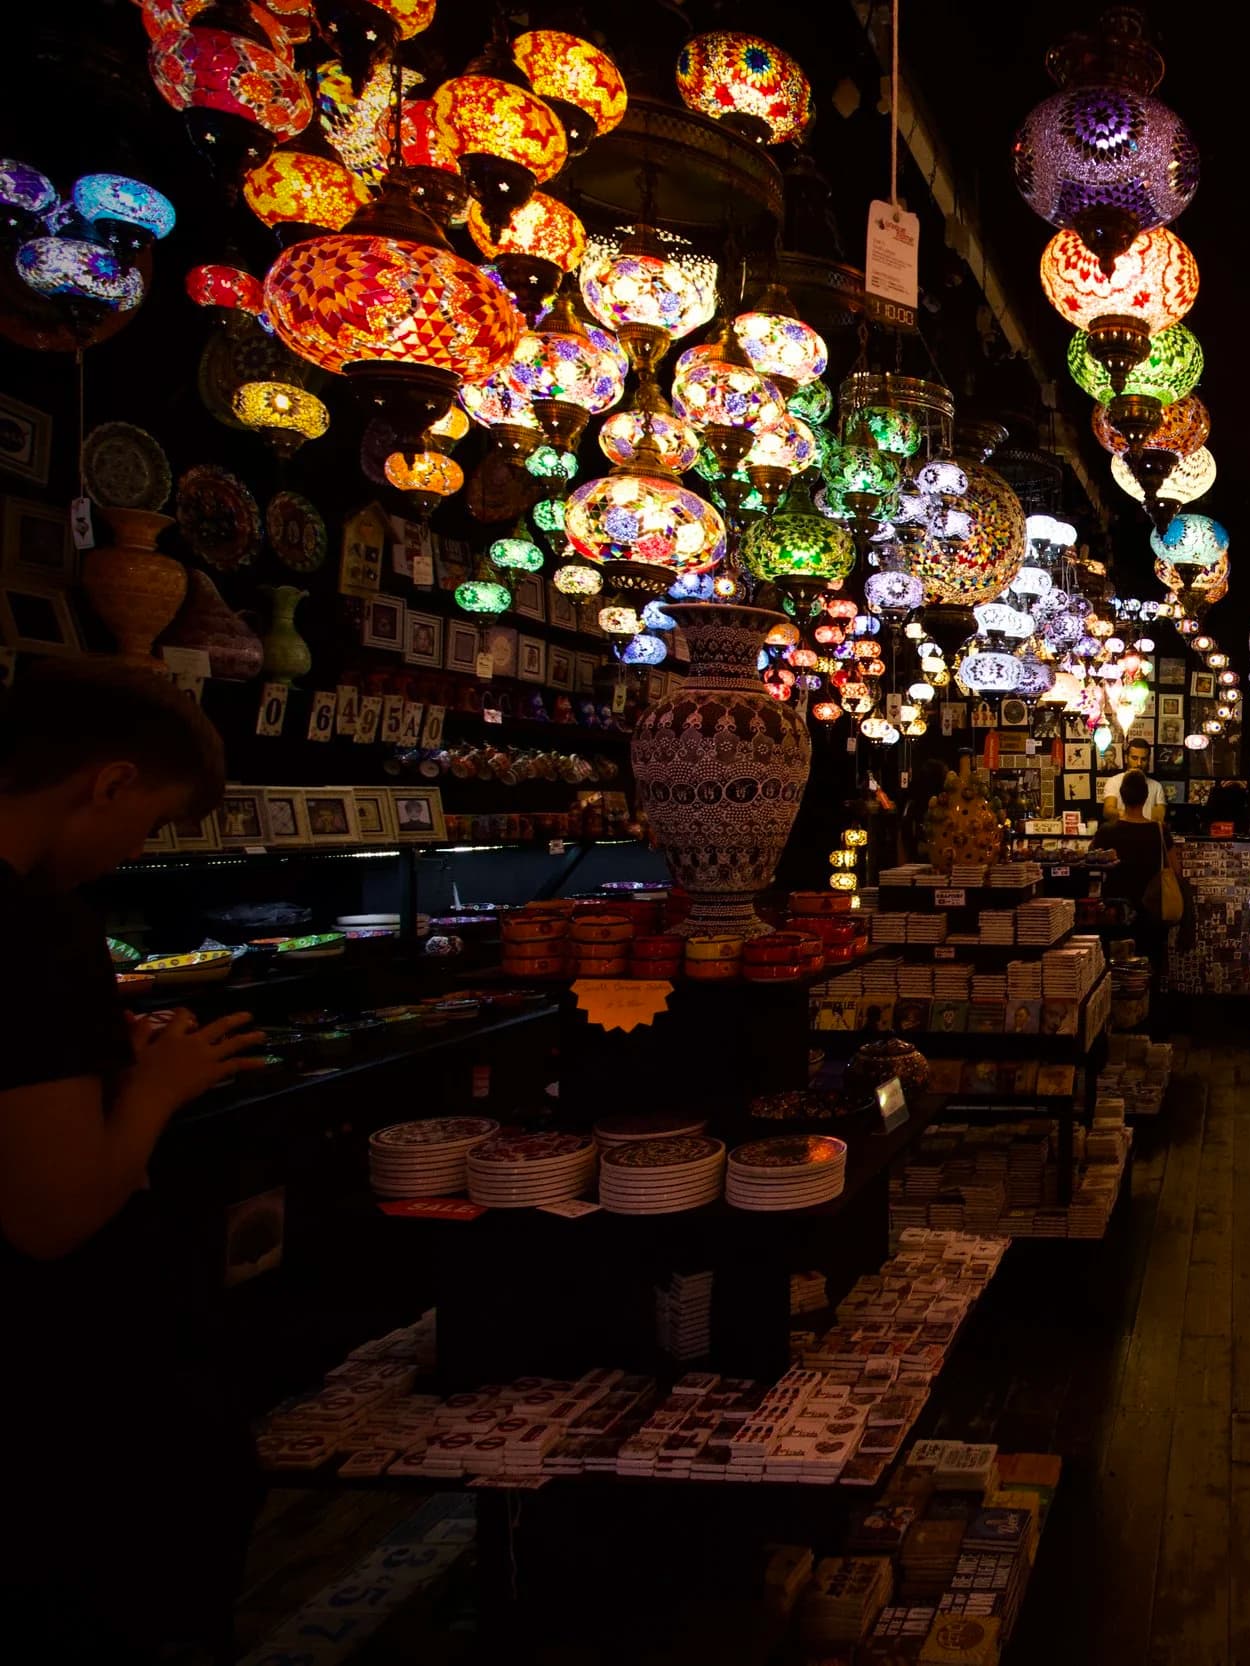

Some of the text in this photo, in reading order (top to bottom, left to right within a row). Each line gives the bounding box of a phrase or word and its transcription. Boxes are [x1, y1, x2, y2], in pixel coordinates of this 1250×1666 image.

[316, 705, 330, 731] 6
[343, 698, 356, 724] 4
[361, 710, 375, 734] 9
[388, 707, 401, 733] 5
[404, 719, 418, 737] A
